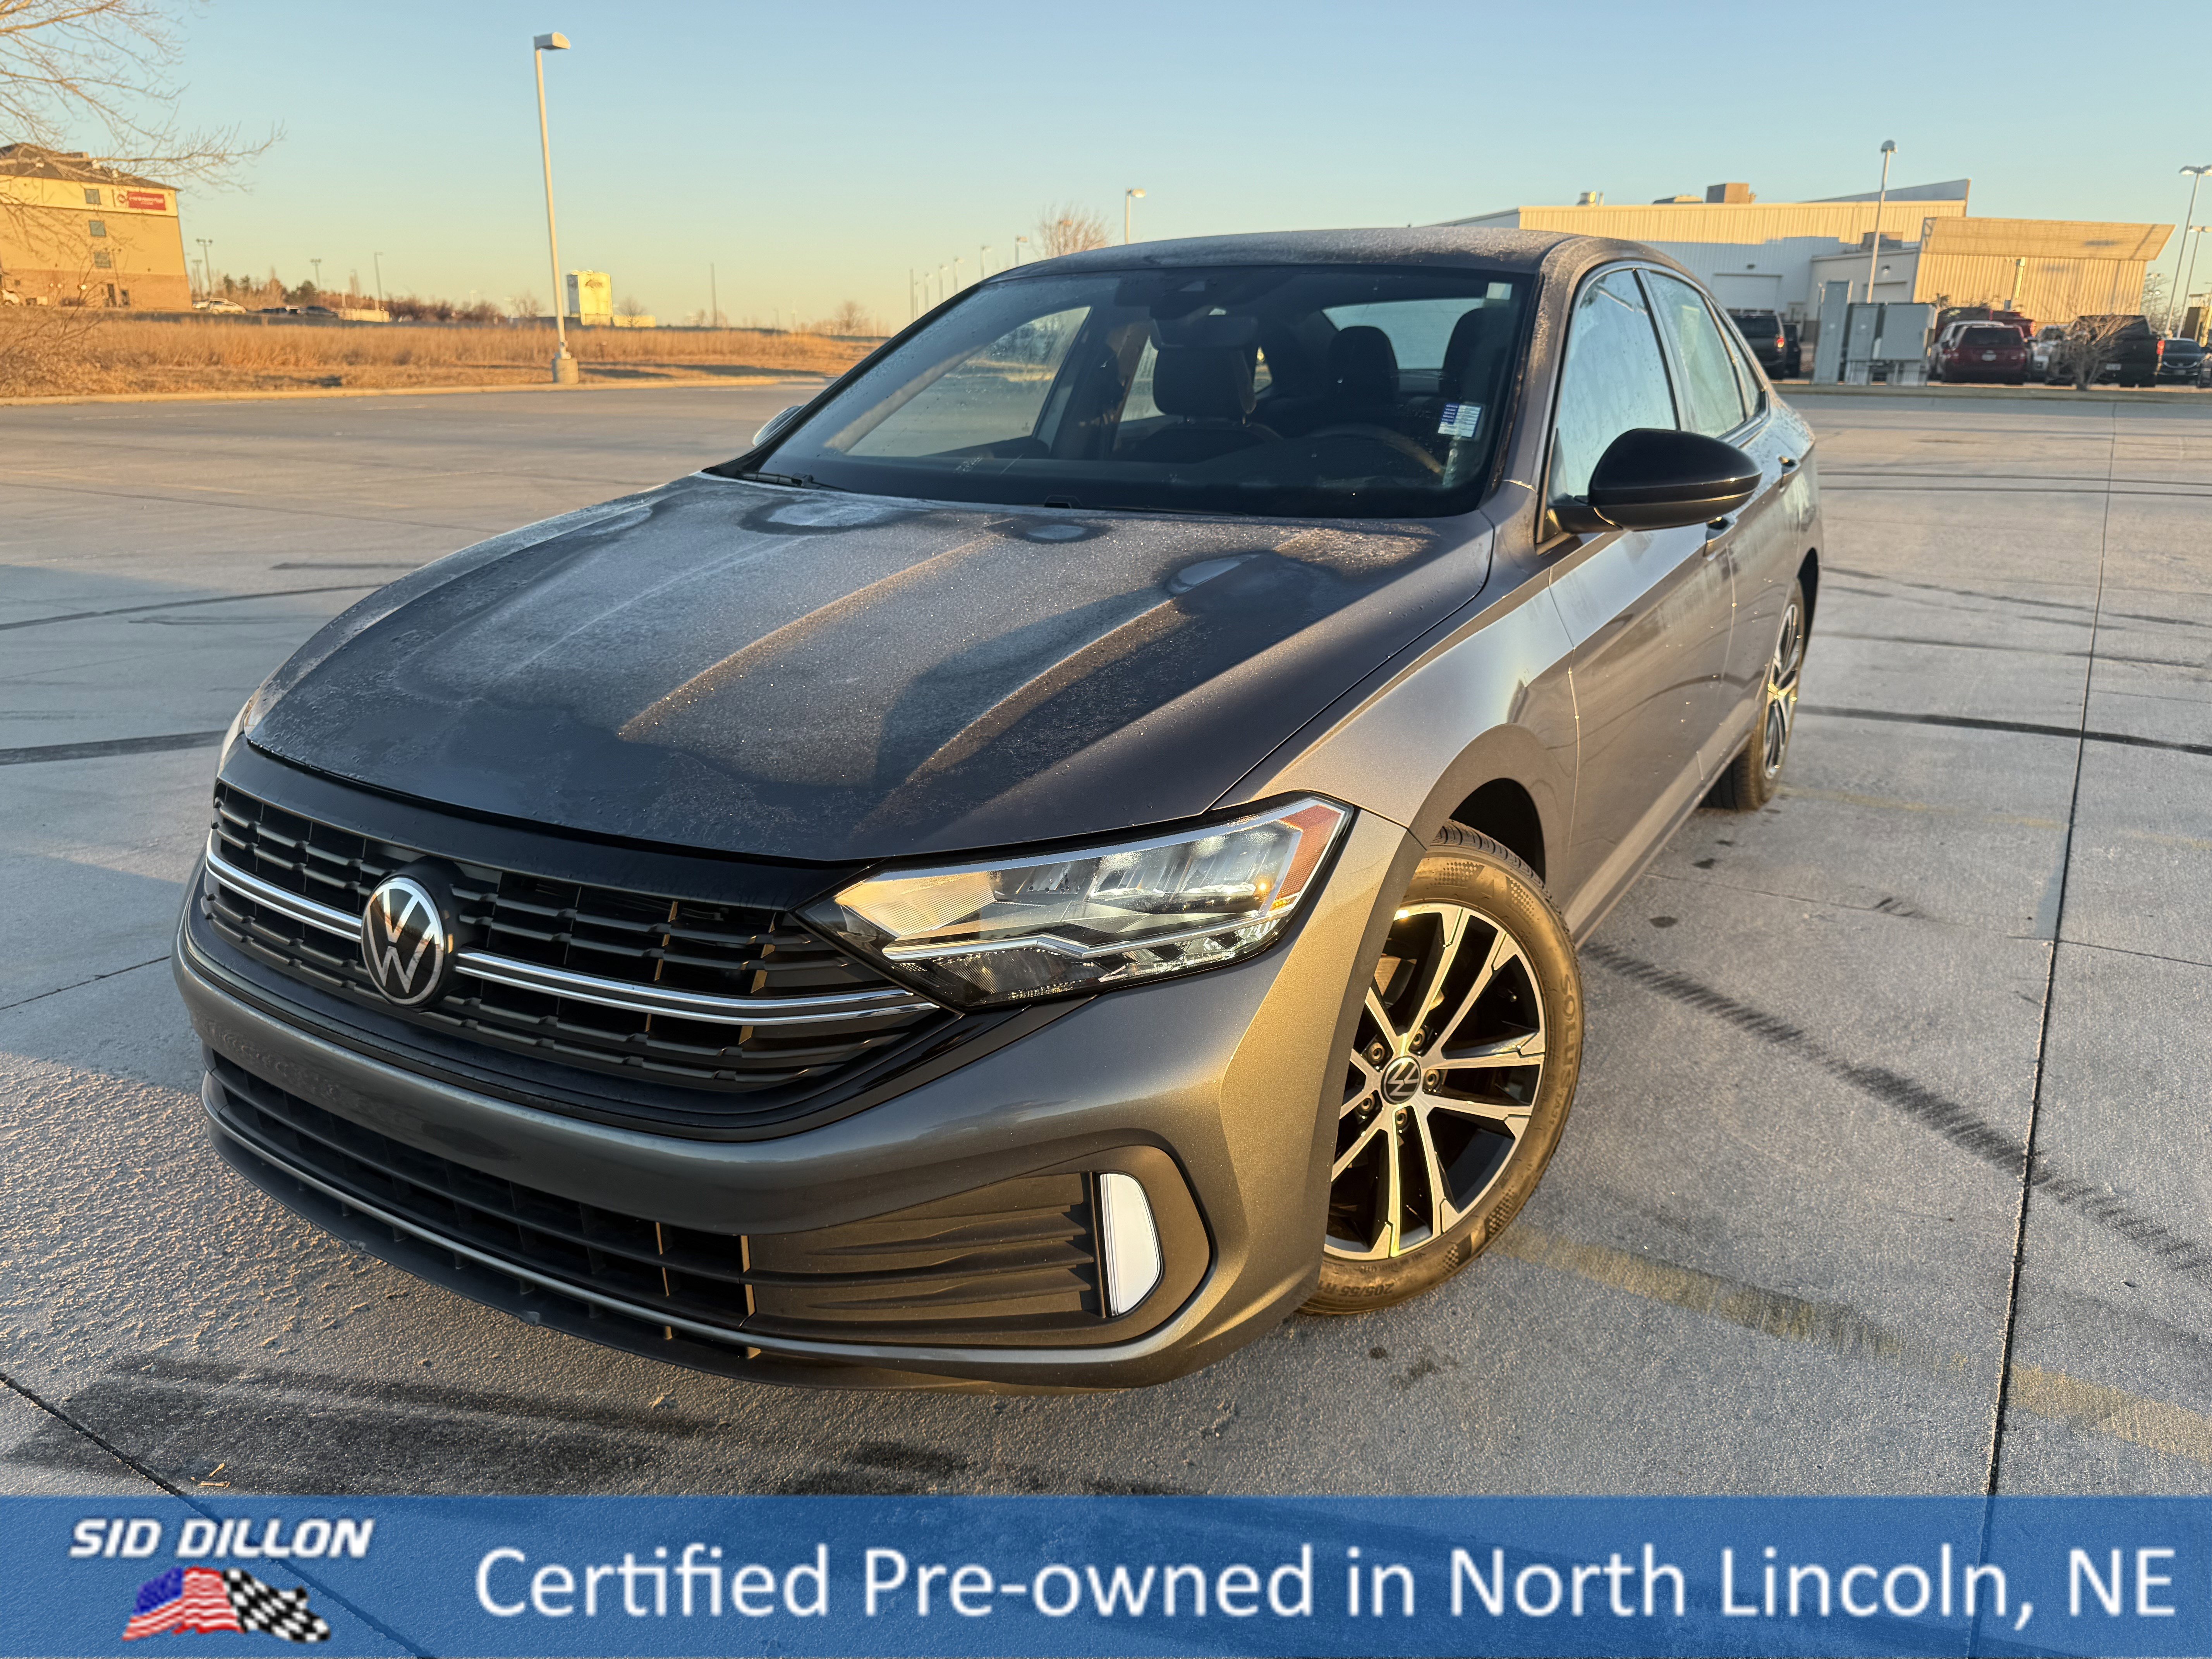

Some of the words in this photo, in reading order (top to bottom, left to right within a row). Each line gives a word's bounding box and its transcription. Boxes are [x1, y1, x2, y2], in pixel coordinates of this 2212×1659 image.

[1560, 974, 1576, 1087] SOLUS
[1318, 1280, 1337, 1295] R1
[1339, 1283, 1394, 1297] 205/55
